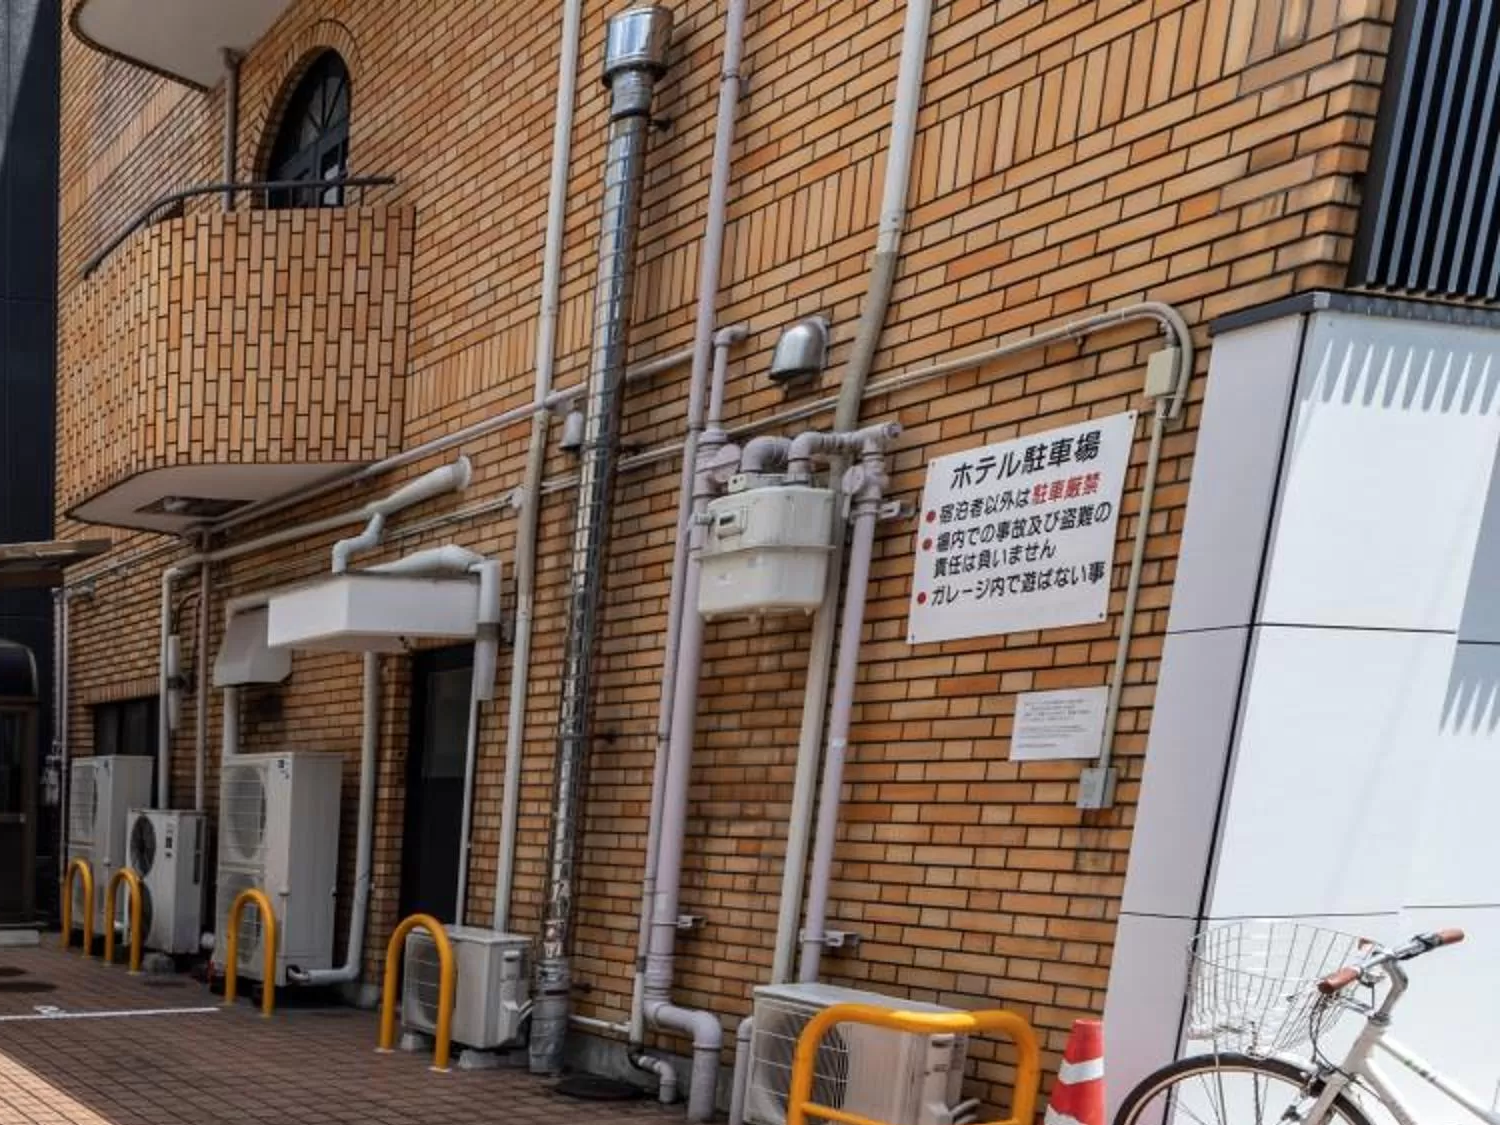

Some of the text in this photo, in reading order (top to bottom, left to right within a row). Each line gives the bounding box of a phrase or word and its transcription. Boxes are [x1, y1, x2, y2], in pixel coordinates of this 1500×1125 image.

[950, 430, 1101, 489] ホテル駐車場
[933, 539, 1056, 579] 責任は負いません
[932, 561, 1106, 606] ガレージ内で遊ばない事
